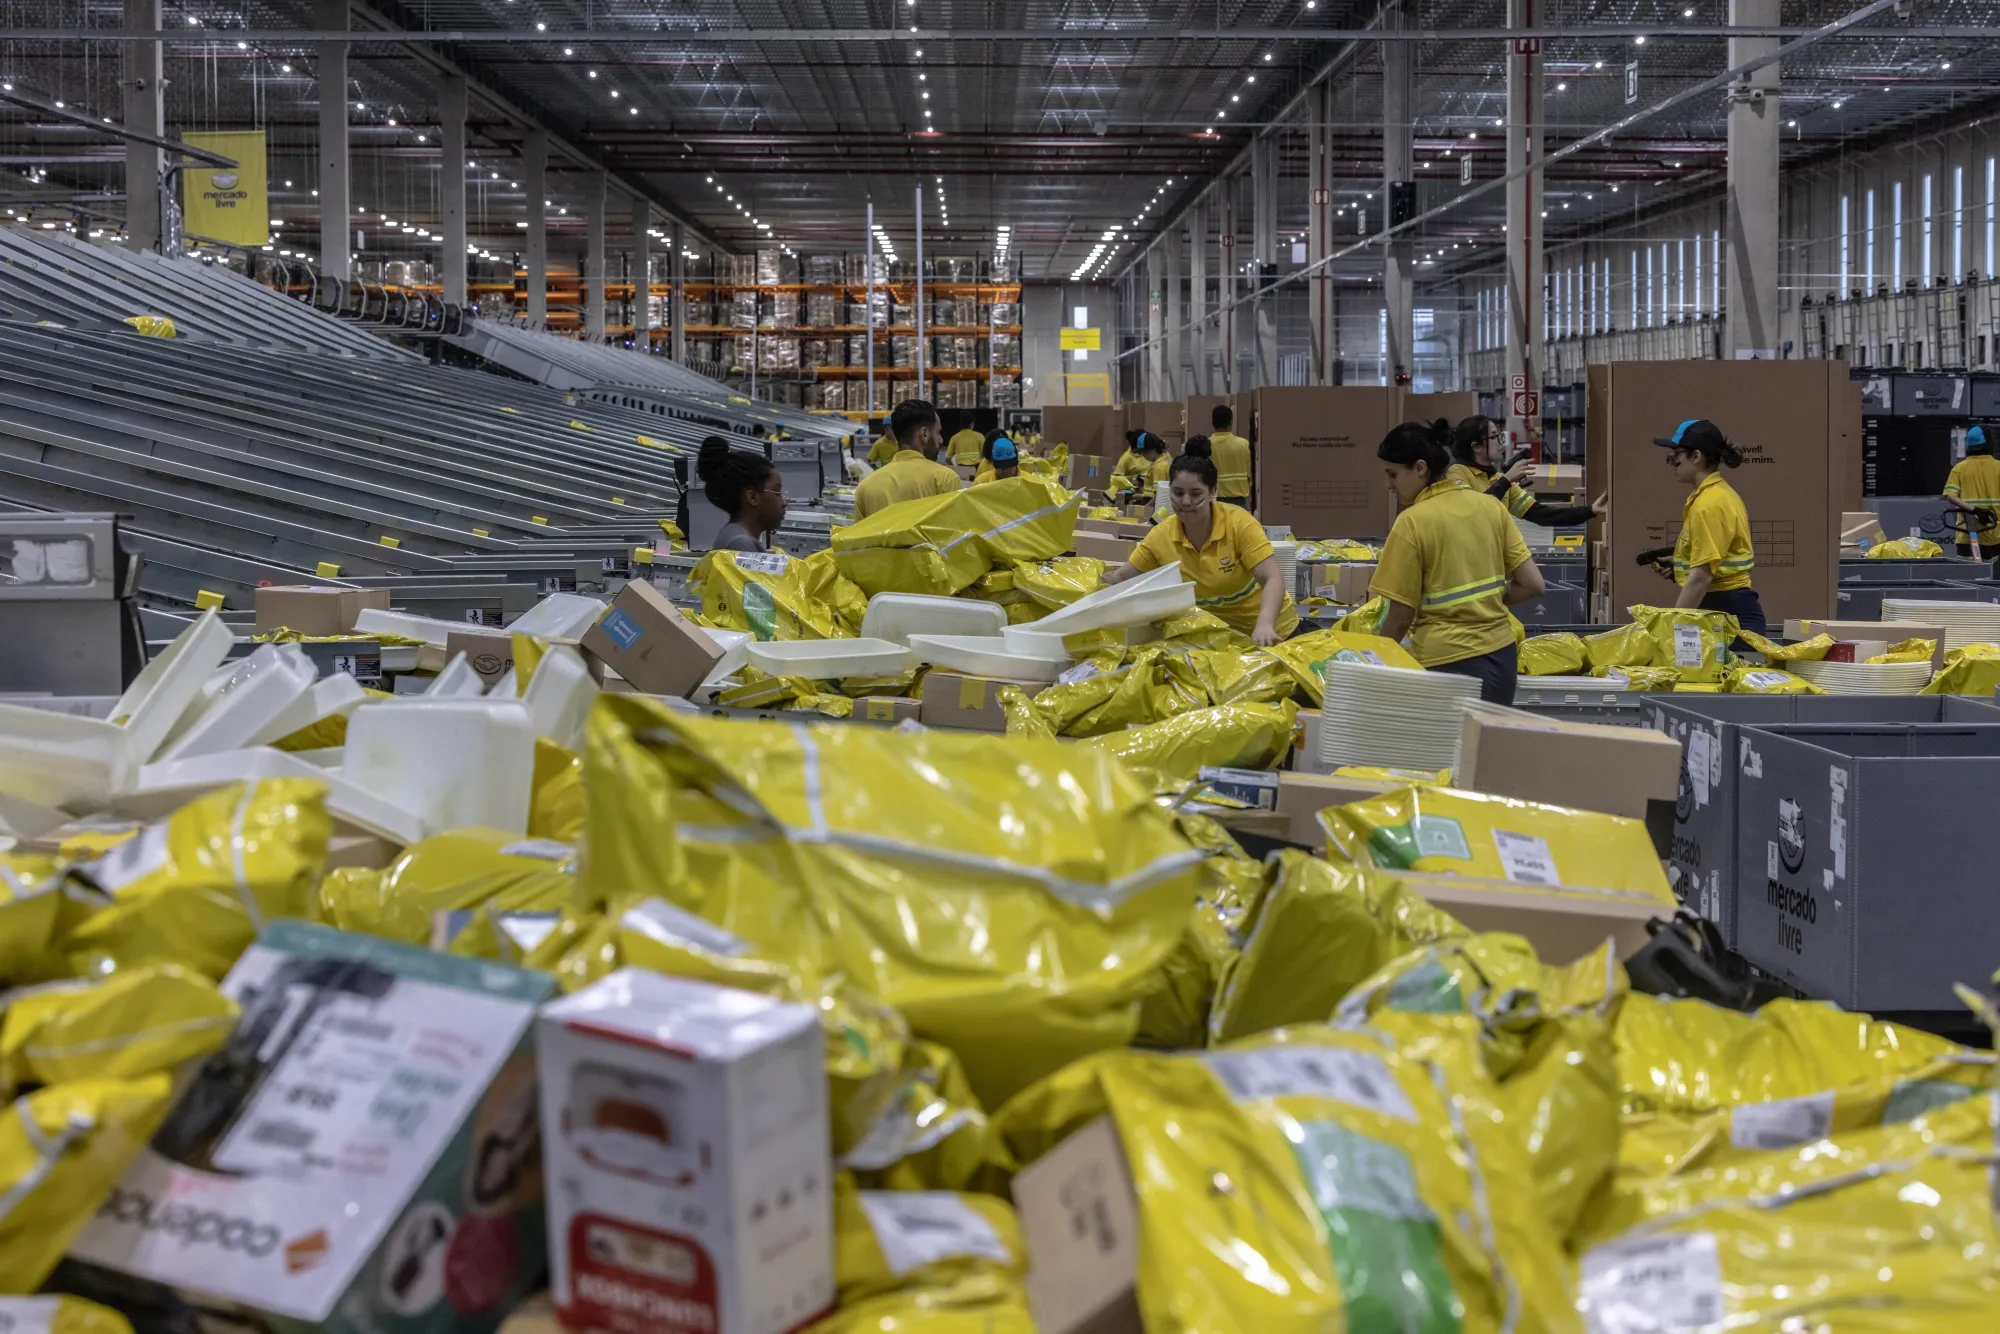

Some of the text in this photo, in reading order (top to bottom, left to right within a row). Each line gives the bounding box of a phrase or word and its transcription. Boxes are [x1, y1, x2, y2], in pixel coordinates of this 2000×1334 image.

[204, 191, 247, 199] mercado
[1751, 456, 1776, 464] mim.
[1670, 835, 1701, 868] ercado
[1767, 879, 1817, 924] mercado
[1778, 914, 1803, 955] livre
